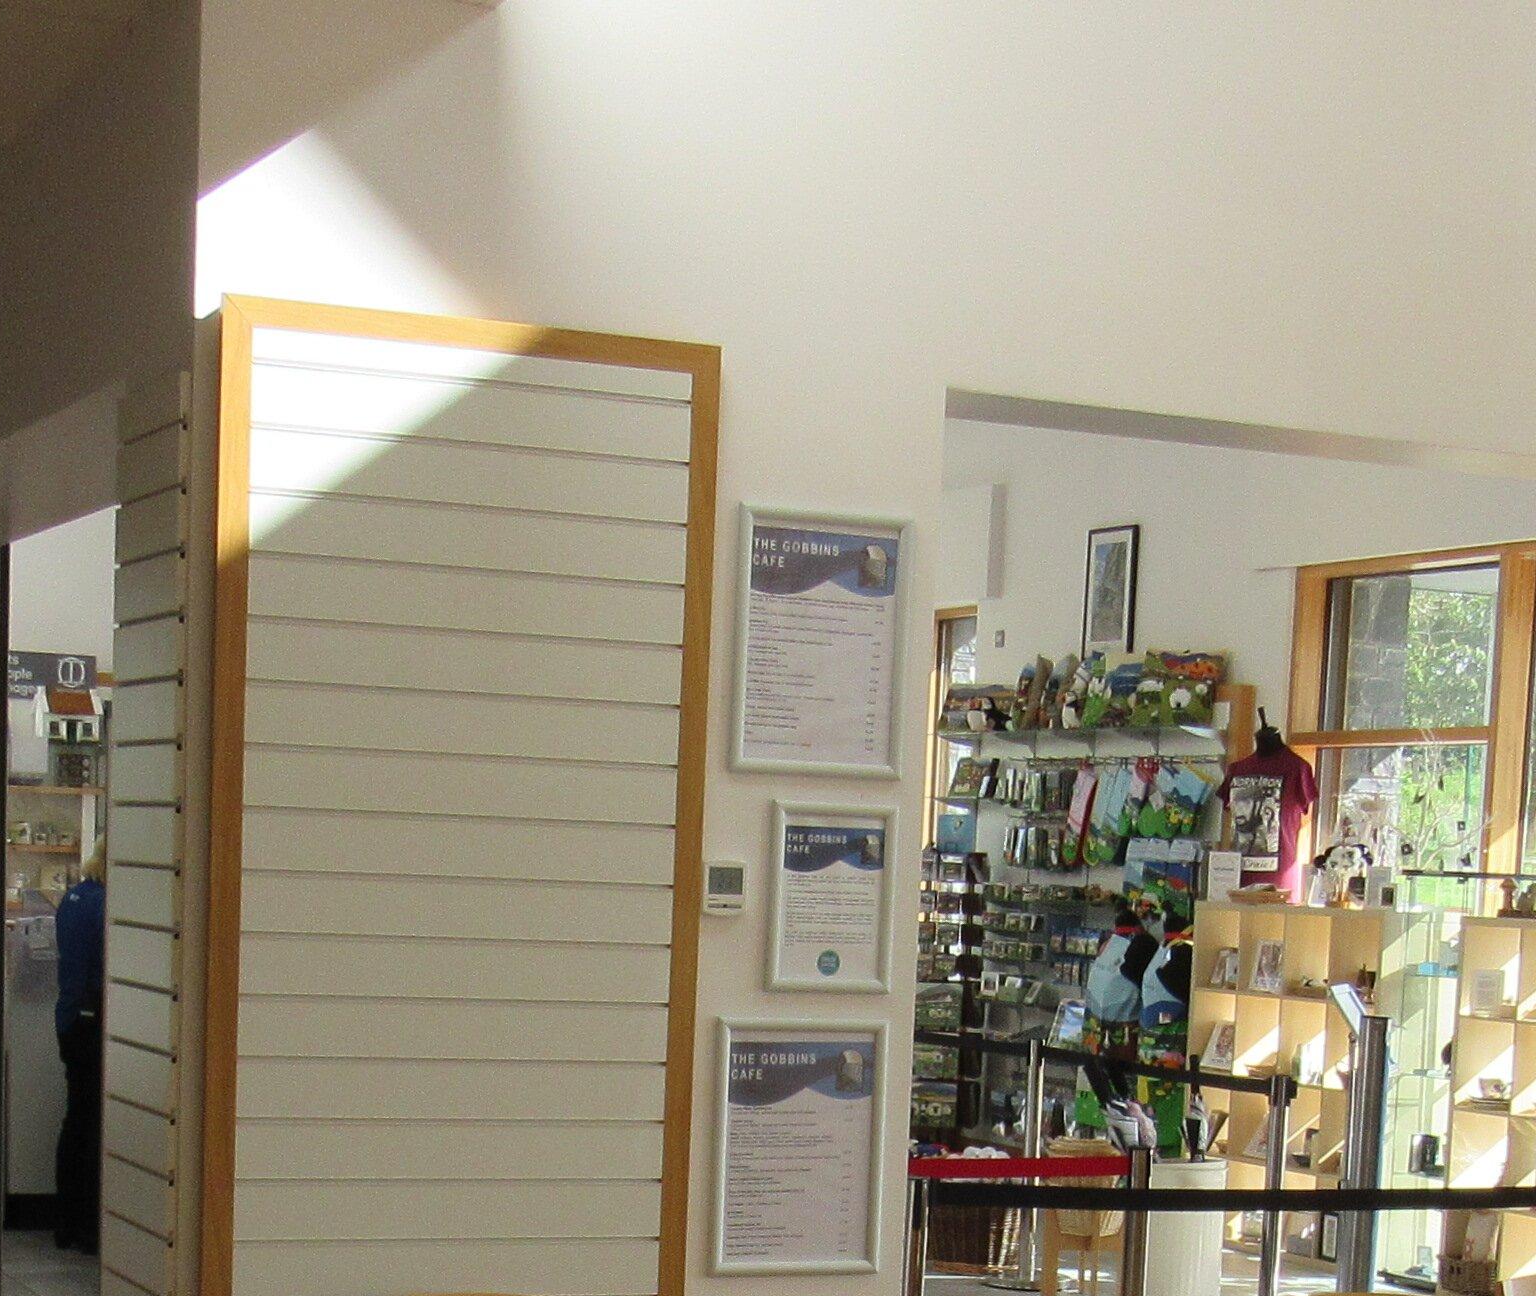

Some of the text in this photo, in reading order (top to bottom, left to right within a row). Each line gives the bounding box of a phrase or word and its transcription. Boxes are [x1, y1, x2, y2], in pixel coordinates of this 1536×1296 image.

[753, 537, 840, 557] THE GOBBINS
[752, 554, 785, 568] CAFE
[787, 832, 848, 845] THE GOBBINS
[786, 844, 810, 854] CAFE
[732, 1053, 816, 1065] THE GOBBINS
[731, 1068, 763, 1080] CAFE
